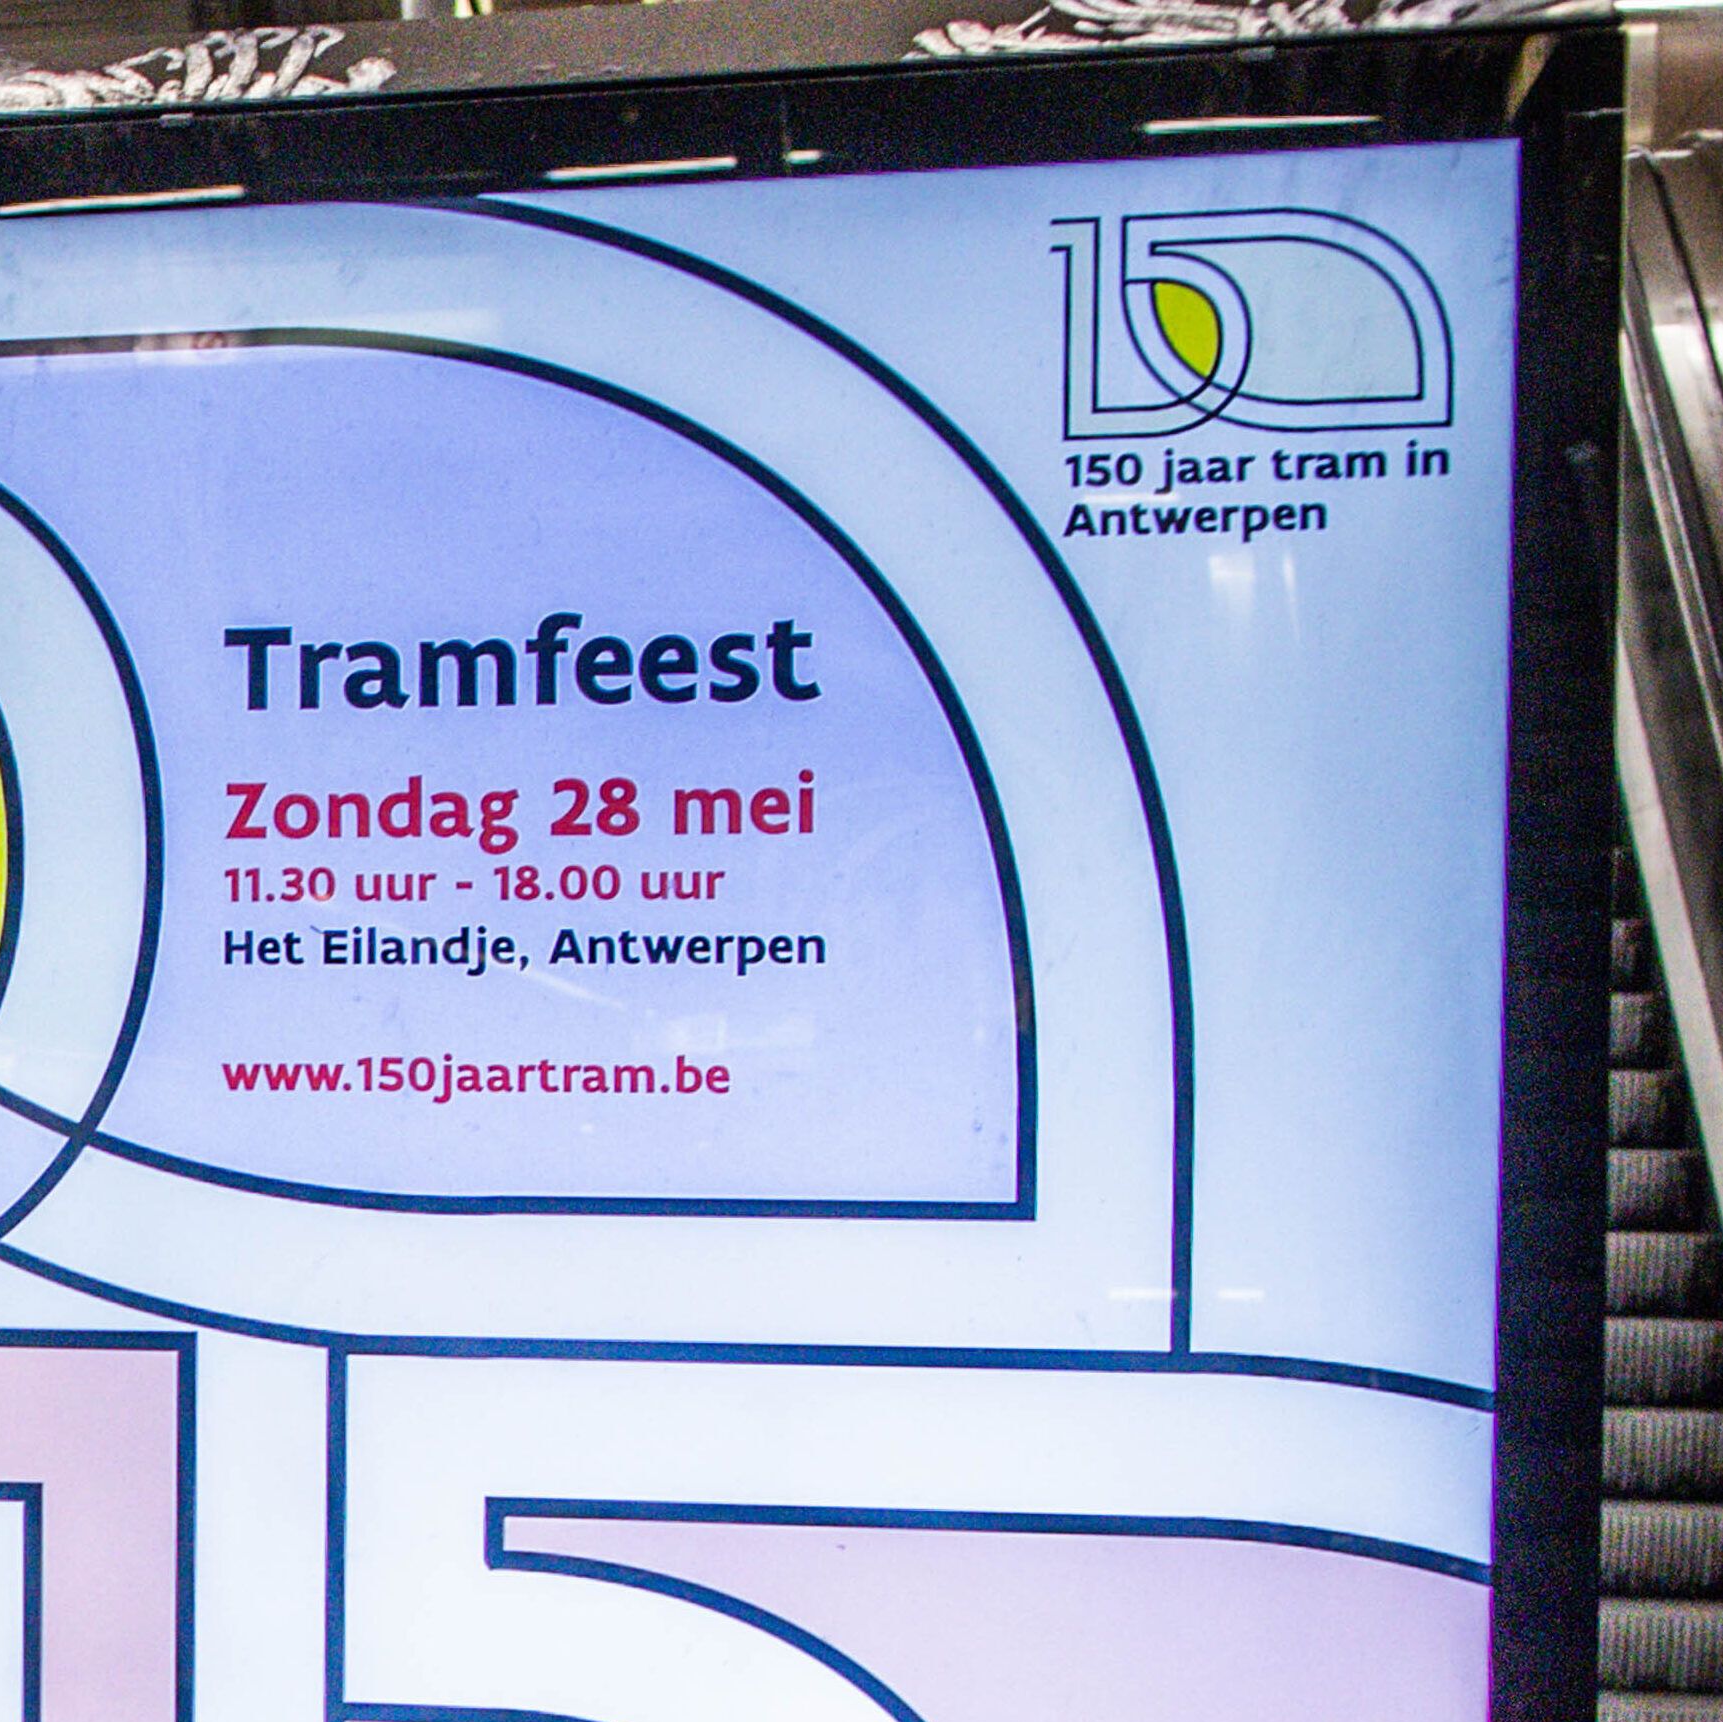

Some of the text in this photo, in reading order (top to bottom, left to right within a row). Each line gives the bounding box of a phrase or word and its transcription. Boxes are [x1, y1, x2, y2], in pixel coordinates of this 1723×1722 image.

[1063, 439, 1449, 495] 150 jaar tram in
[1063, 503, 1326, 543] Antwerpen
[224, 613, 820, 711] Tramfeest
[226, 769, 814, 855] Zondag 28 mei
[224, 864, 725, 903] 11.30 uur - 18.00 uur
[224, 926, 825, 977] Het Eilandje, Antwerpen
[222, 1053, 730, 1104] www.150jaartram.be
